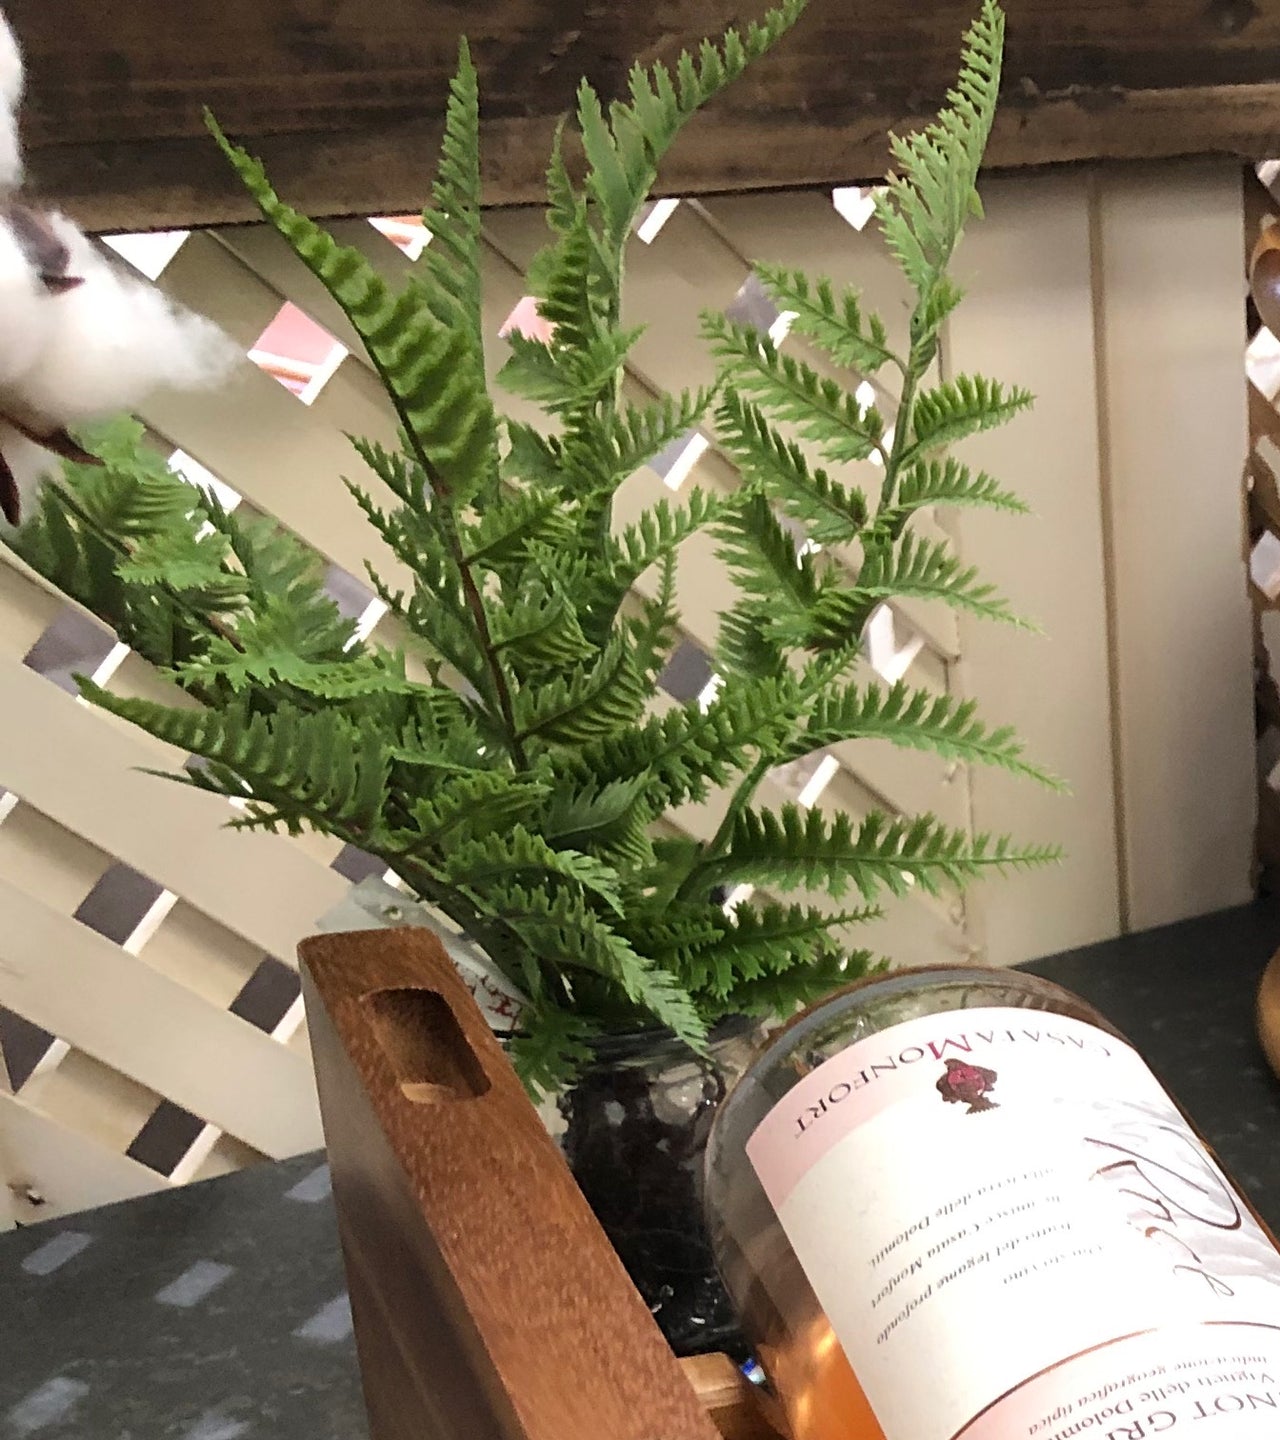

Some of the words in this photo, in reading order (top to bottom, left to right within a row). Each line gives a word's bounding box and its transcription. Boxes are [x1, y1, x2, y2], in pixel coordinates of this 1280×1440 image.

[870, 1256, 923, 1310] Monfort
[937, 1252, 990, 1290] legame
[876, 1284, 932, 1346] profondo
[1077, 1364, 1167, 1408] geografica
[1138, 1380, 1191, 1403] delle
[1027, 1403, 1074, 1438] tipica
